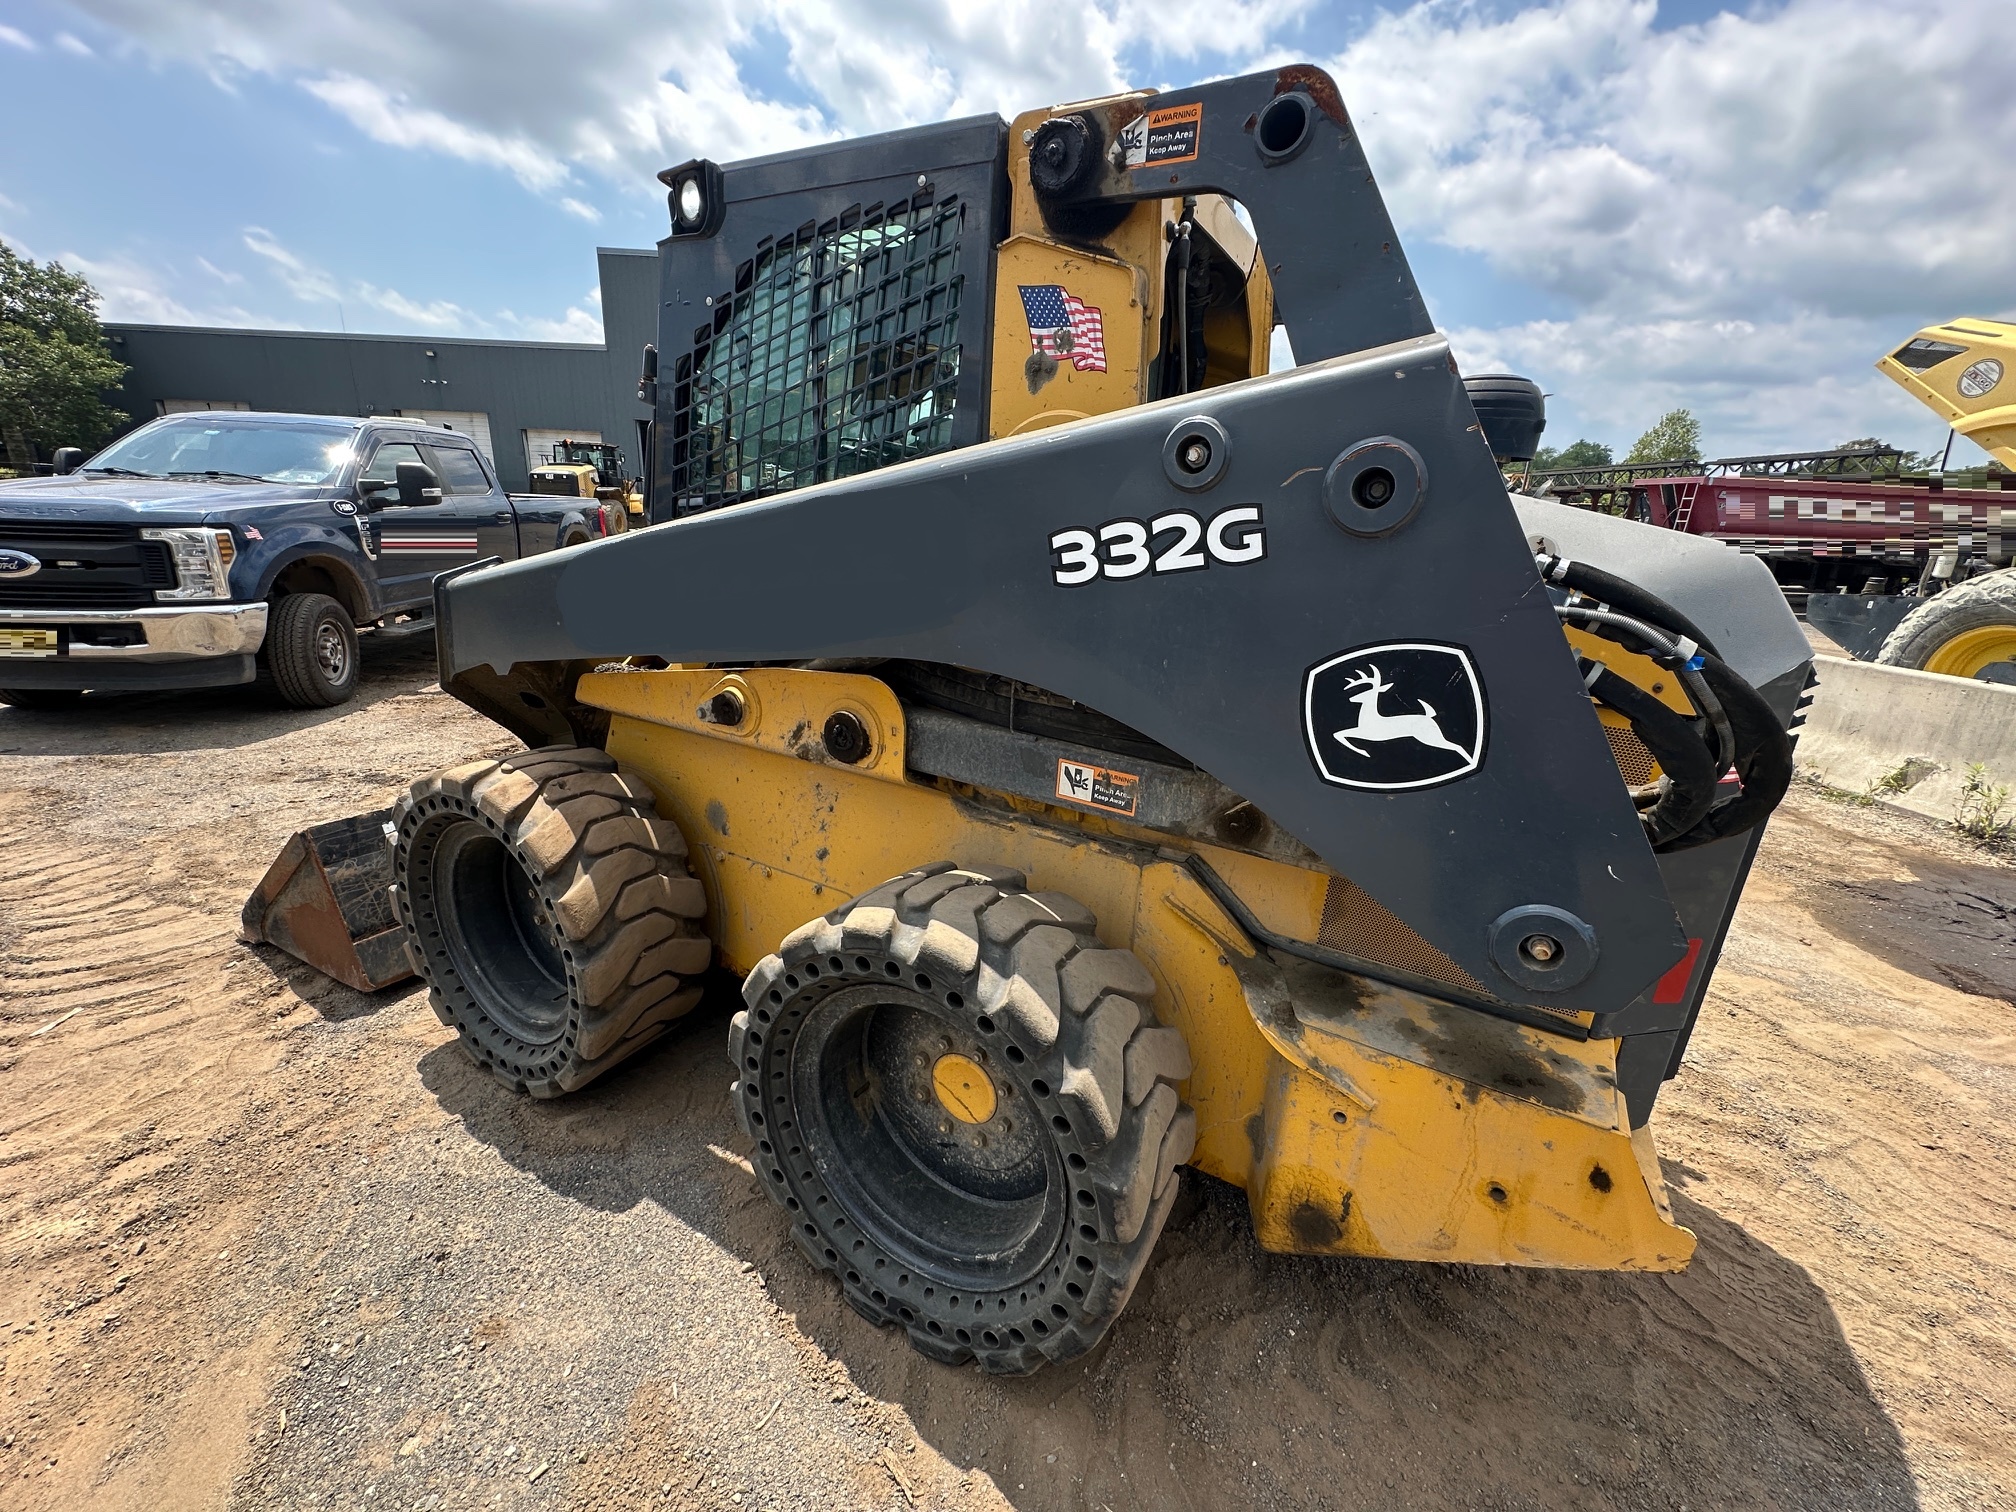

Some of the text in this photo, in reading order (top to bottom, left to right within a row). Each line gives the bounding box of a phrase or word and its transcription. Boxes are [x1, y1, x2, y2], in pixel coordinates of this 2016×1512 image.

[1160, 108, 1197, 121] WARNING
[1150, 131, 1193, 144] Pinch Area
[1149, 143, 1186, 155] Keep Away
[1048, 503, 1268, 588] 332G
[1104, 774, 1137, 784] ARNING
[1094, 784, 1114, 795] Pinch
[1093, 793, 1126, 806] Keep Away
